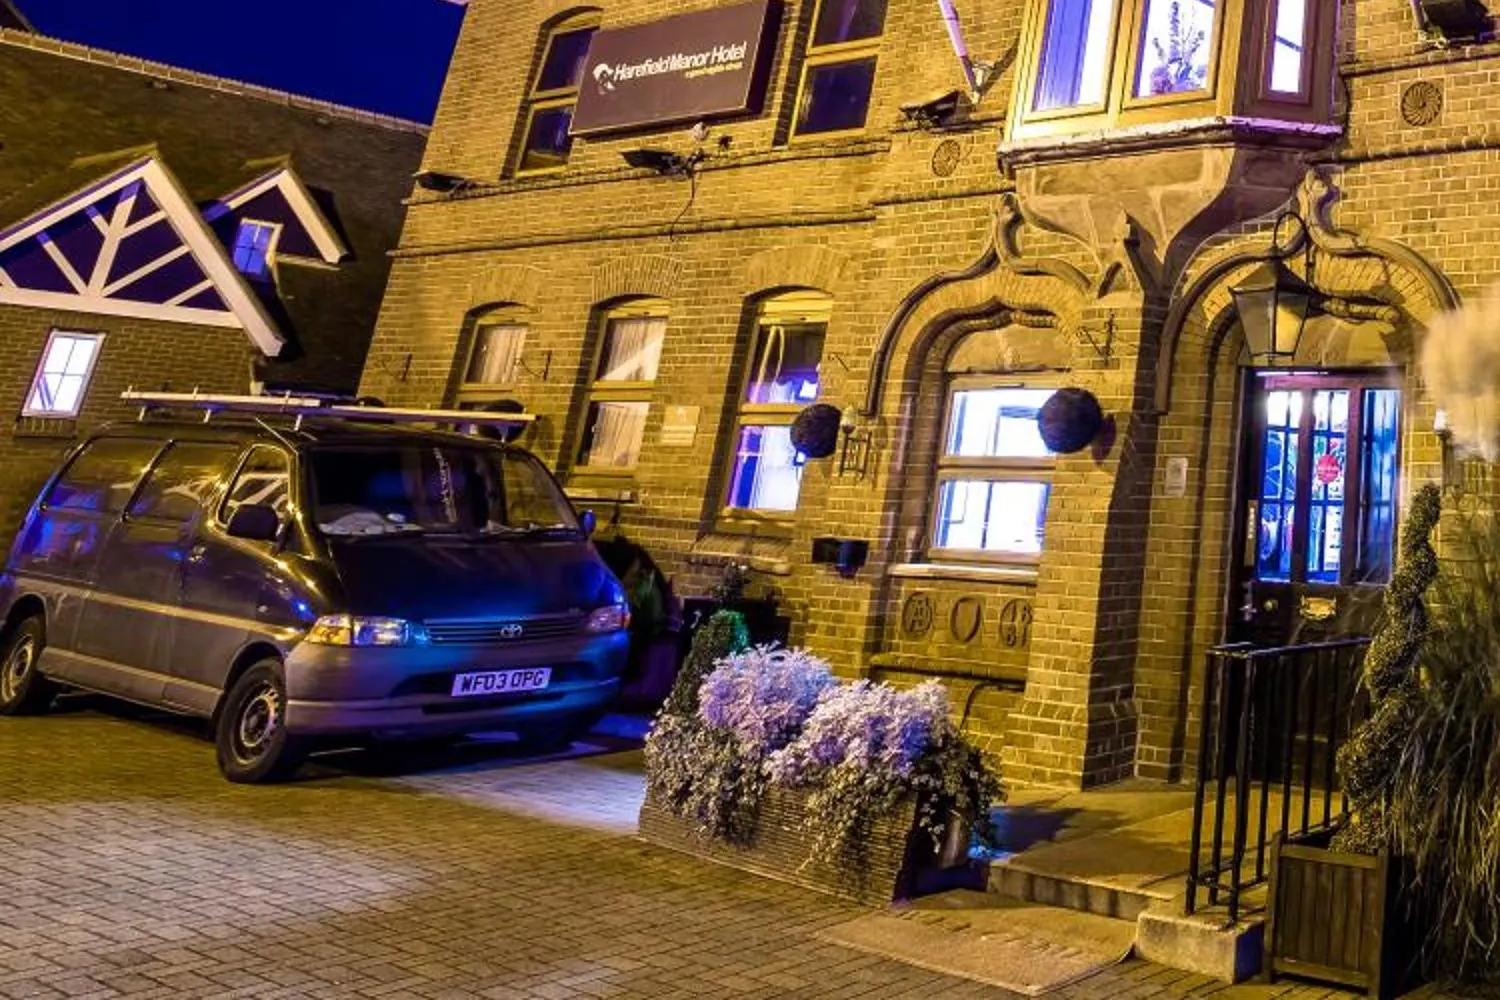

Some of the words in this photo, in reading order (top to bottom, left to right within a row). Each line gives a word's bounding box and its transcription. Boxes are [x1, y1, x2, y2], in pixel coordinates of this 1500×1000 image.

[614, 56, 669, 81] Harefield
[669, 52, 711, 70] Manor
[711, 41, 748, 64] Hotel
